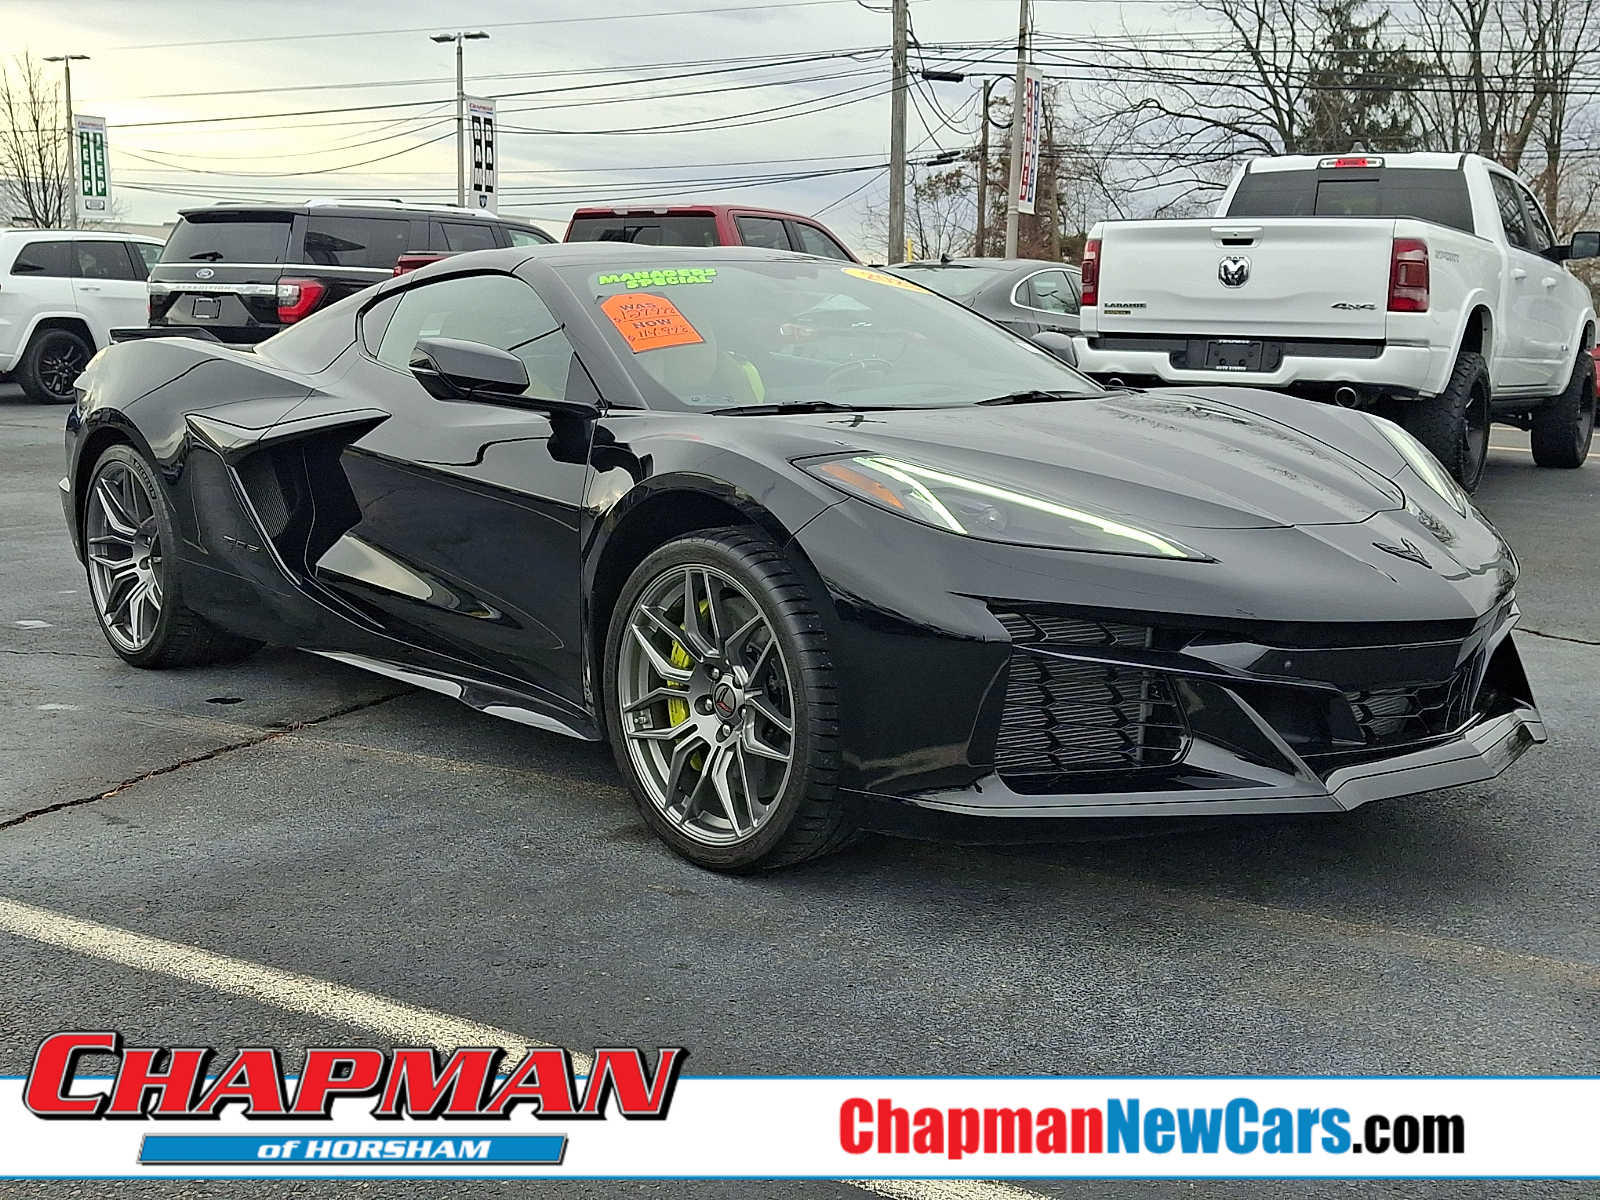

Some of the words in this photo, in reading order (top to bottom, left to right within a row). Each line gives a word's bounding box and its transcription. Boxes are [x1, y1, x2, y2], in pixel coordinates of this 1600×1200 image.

[81, 132, 92, 194] JEEP
[94, 133, 105, 195] JEEP
[472, 119, 483, 189] RAM
[484, 120, 494, 190] RAM
[620, 302, 657, 311] WAS
[626, 276, 713, 289] SPECIAL
[633, 319, 673, 329] NOW
